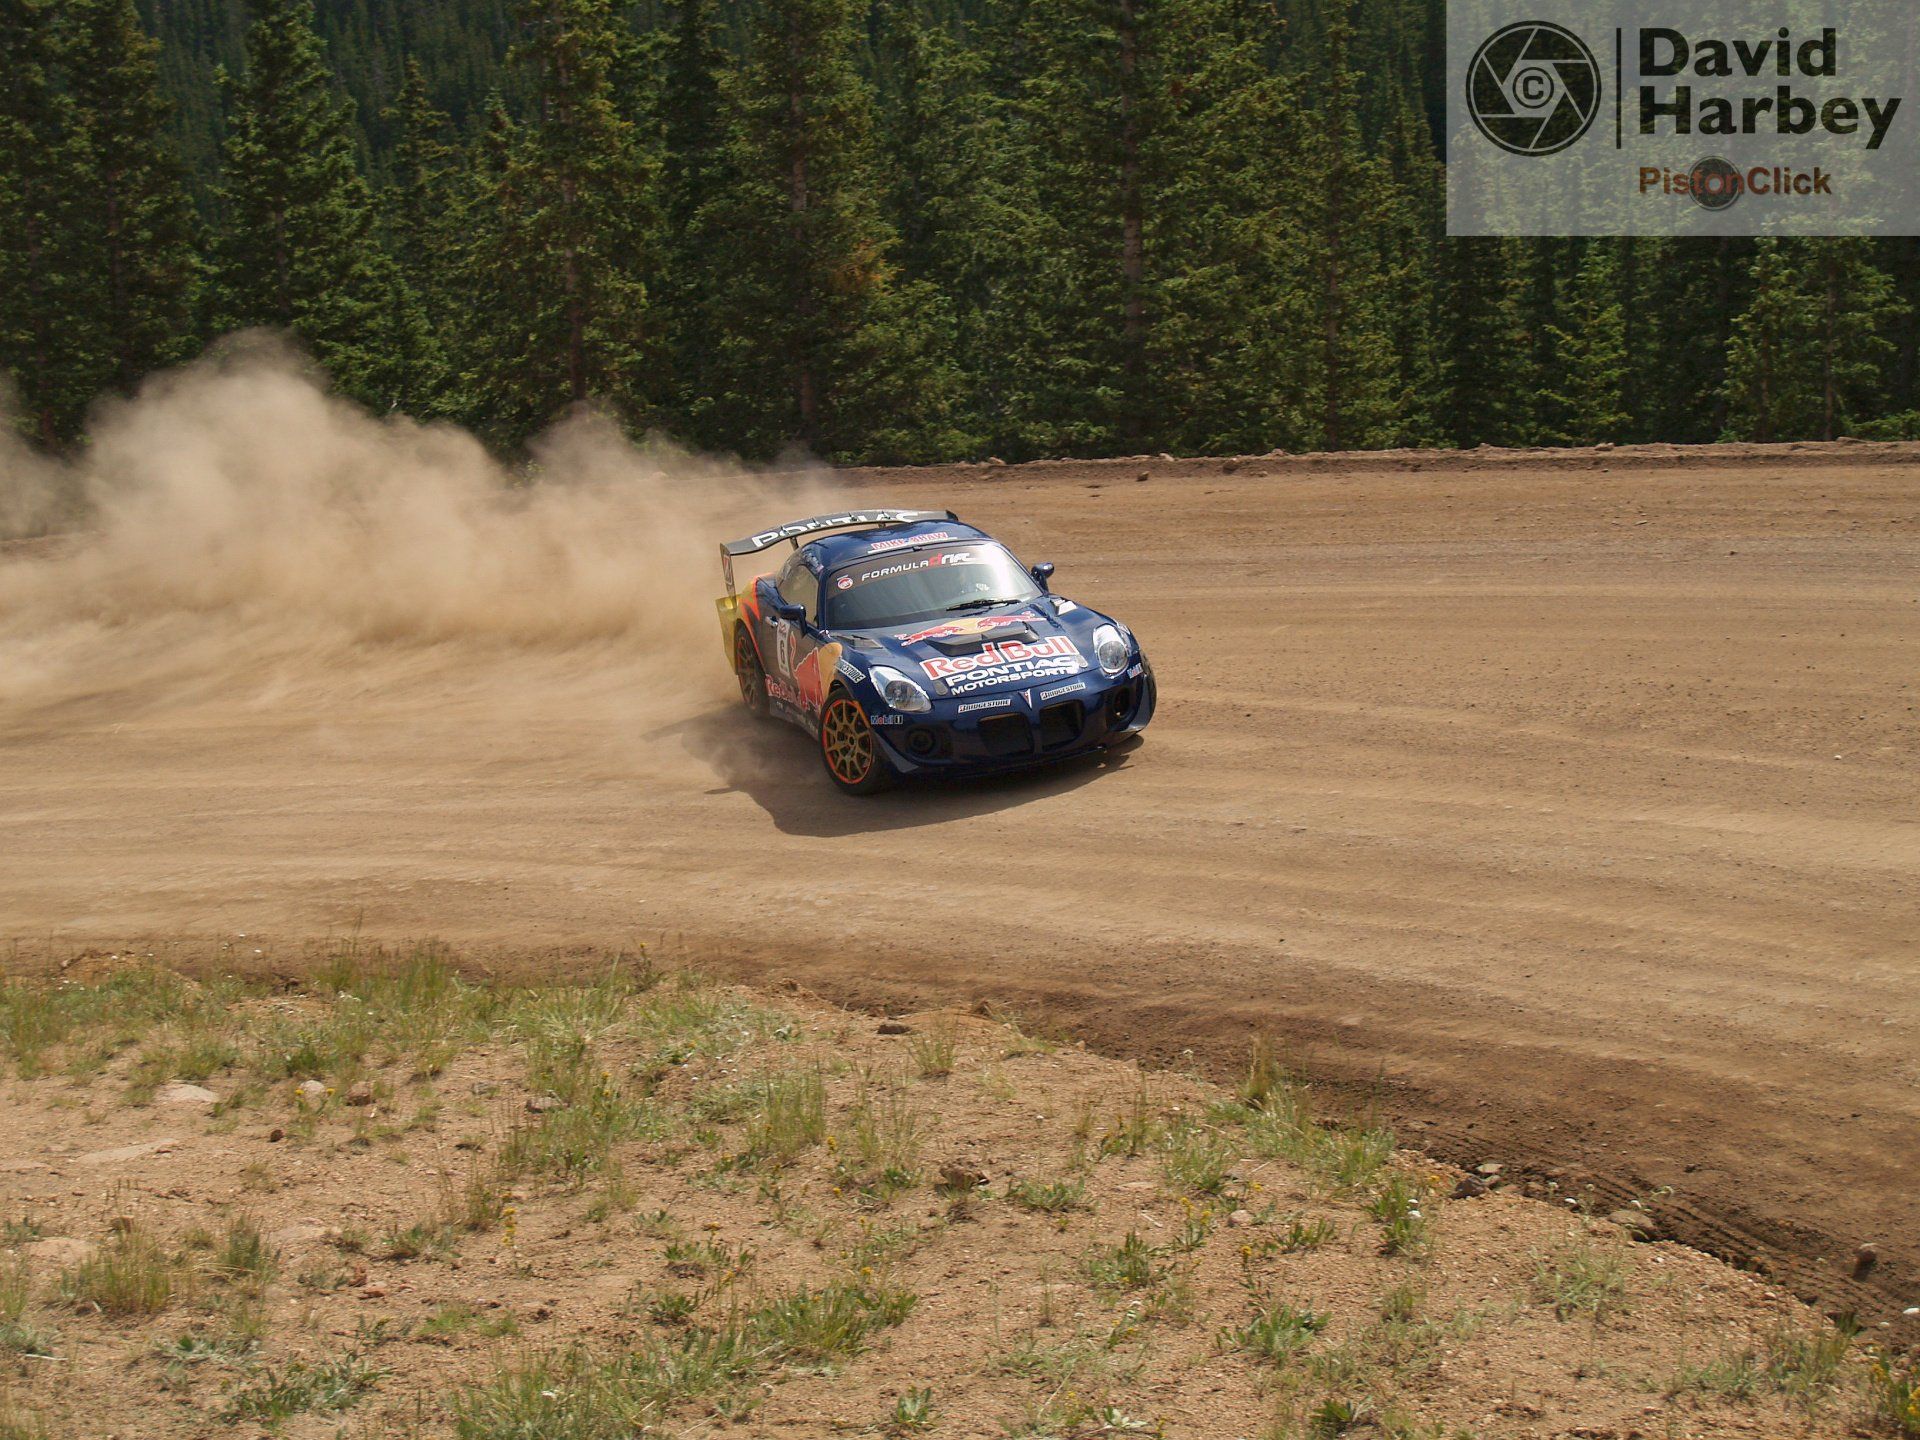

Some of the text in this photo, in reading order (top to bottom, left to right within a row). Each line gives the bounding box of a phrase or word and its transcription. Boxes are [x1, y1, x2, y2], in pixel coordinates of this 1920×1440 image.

[751, 511, 919, 548] PONTIAC
[861, 560, 929, 582] FORMULA
[779, 638, 787, 665] 6
[918, 635, 1080, 681] Red Bull
[944, 656, 1080, 687] PONTIAC
[950, 664, 1081, 696] MOTORSPORTS
[1041, 682, 1086, 700] BRIDGESTONE
[958, 699, 1011, 713] BRIDGESTONE
